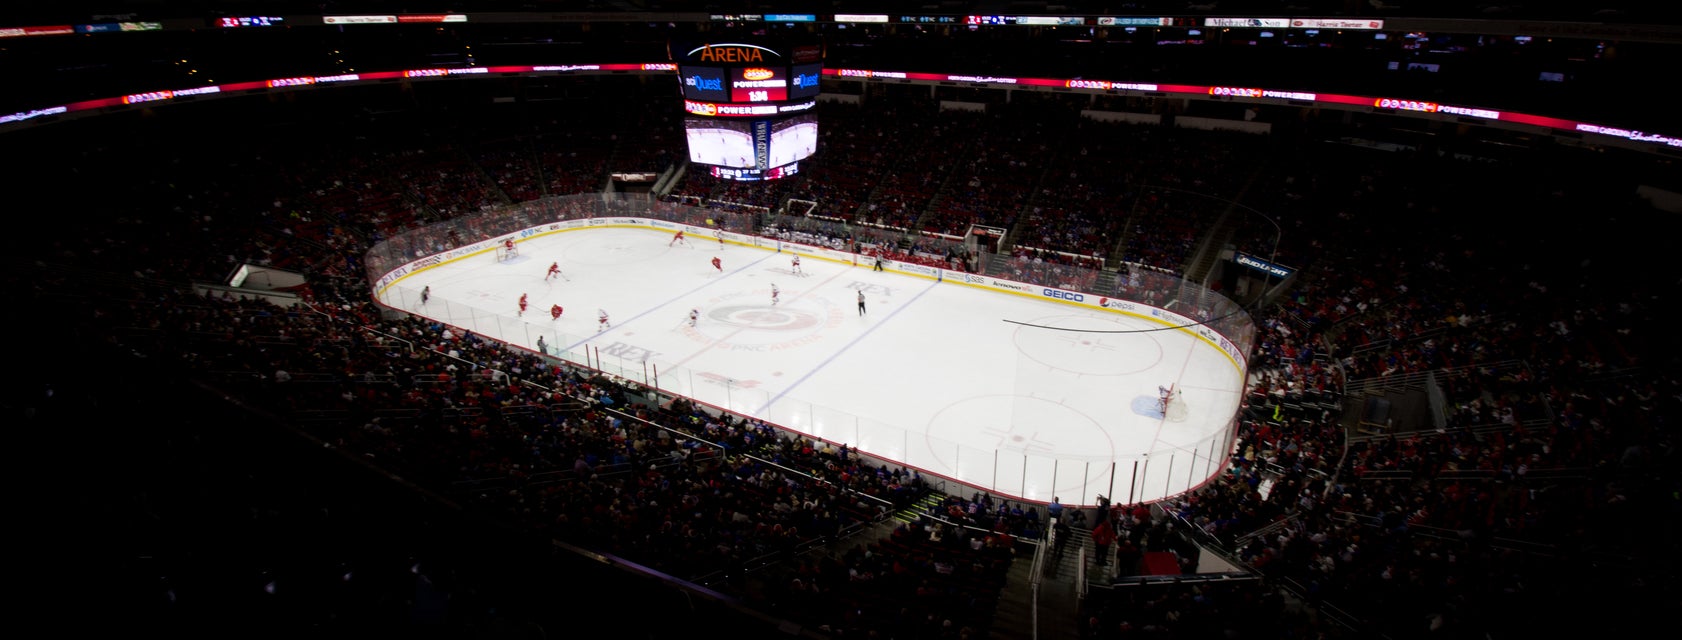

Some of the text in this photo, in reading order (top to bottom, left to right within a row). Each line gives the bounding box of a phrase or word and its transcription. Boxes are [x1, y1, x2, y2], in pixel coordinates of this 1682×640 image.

[1213, 18, 1247, 26] Michael
[700, 44, 764, 62] ARENA
[844, 281, 899, 297] REX
[1043, 288, 1084, 302] GEICO
[1111, 301, 1135, 314] pepsi
[600, 340, 663, 364] REX
